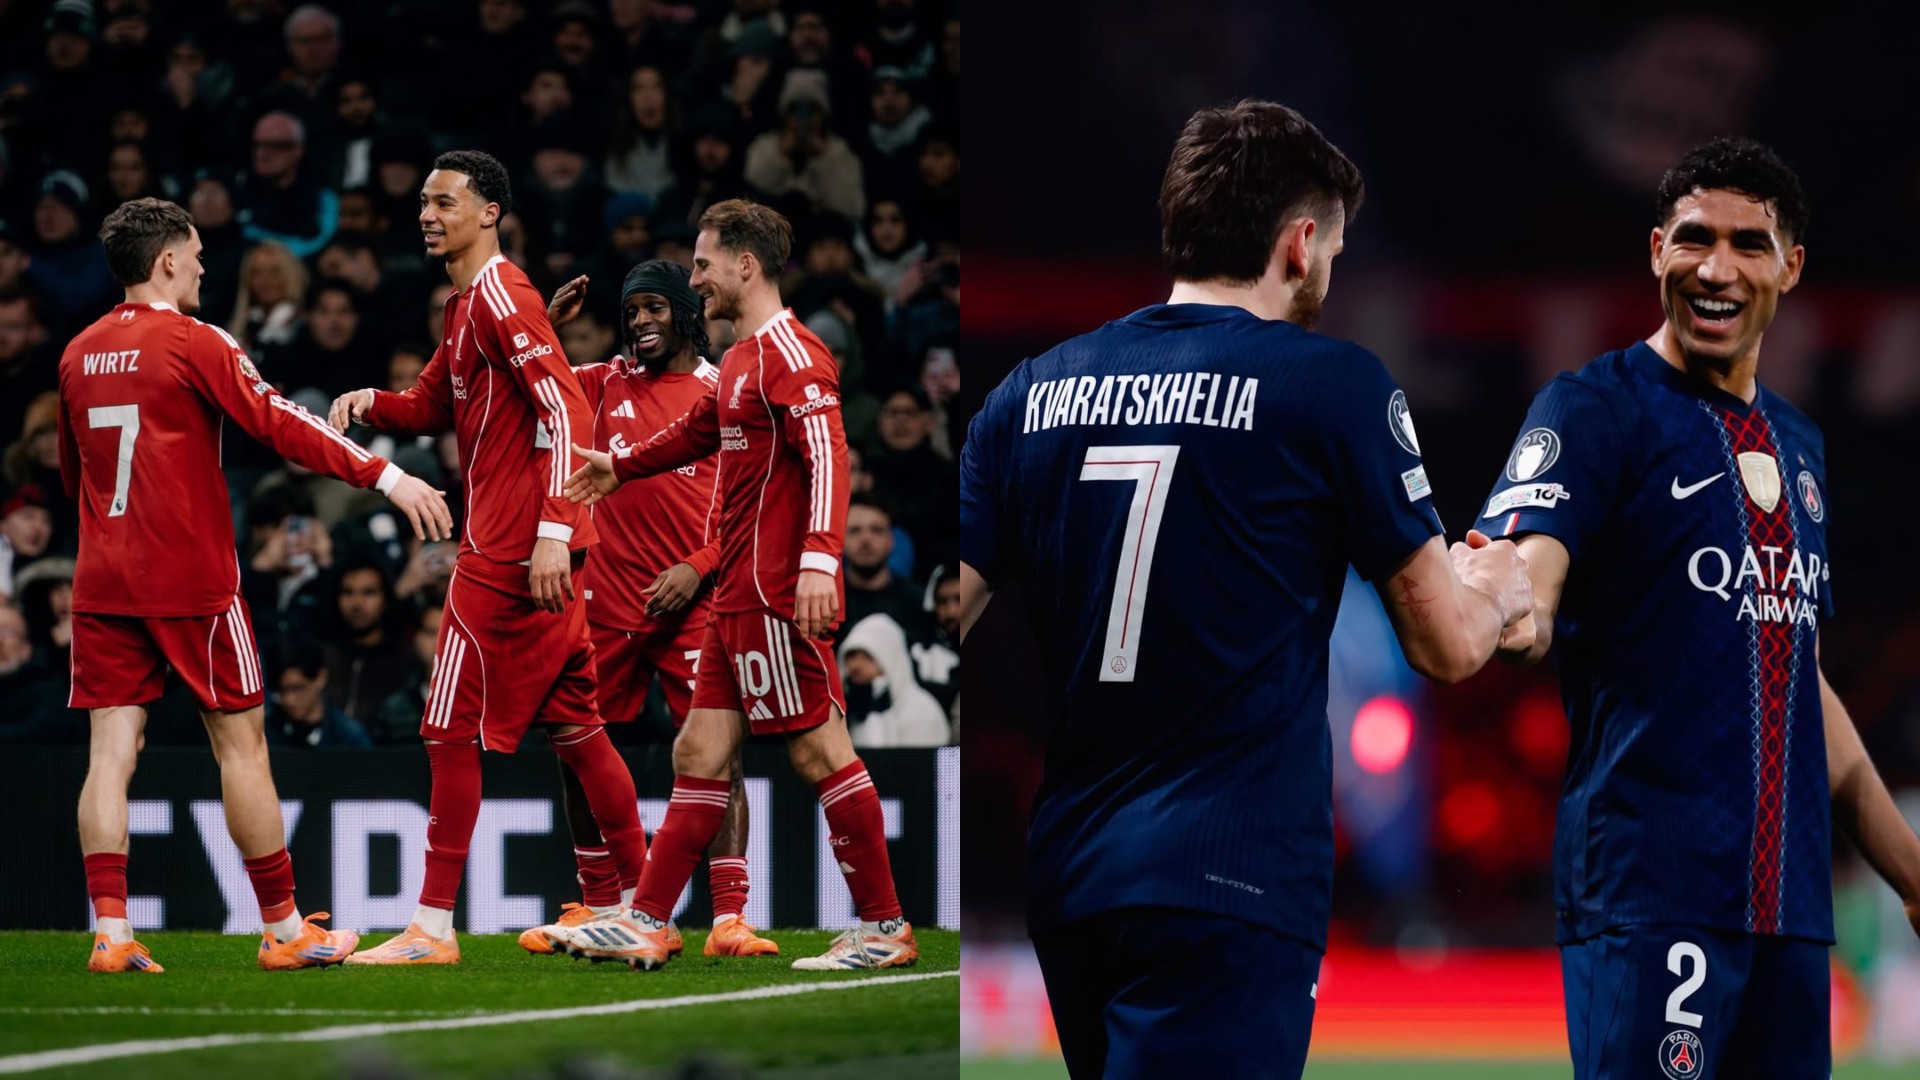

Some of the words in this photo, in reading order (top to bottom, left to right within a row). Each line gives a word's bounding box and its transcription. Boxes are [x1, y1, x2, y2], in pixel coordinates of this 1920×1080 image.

[84, 350, 140, 375] WIRTZ
[1023, 372, 1259, 434] KVARATSKHELIA
[88, 404, 141, 517] 7
[1079, 445, 1181, 682] 7
[1687, 545, 1821, 601] QATAR
[1736, 594, 1819, 631] AIRWAS
[735, 650, 772, 698] 10
[1665, 941, 1707, 1029] 2
[1668, 1033, 1699, 1049] PARIS
